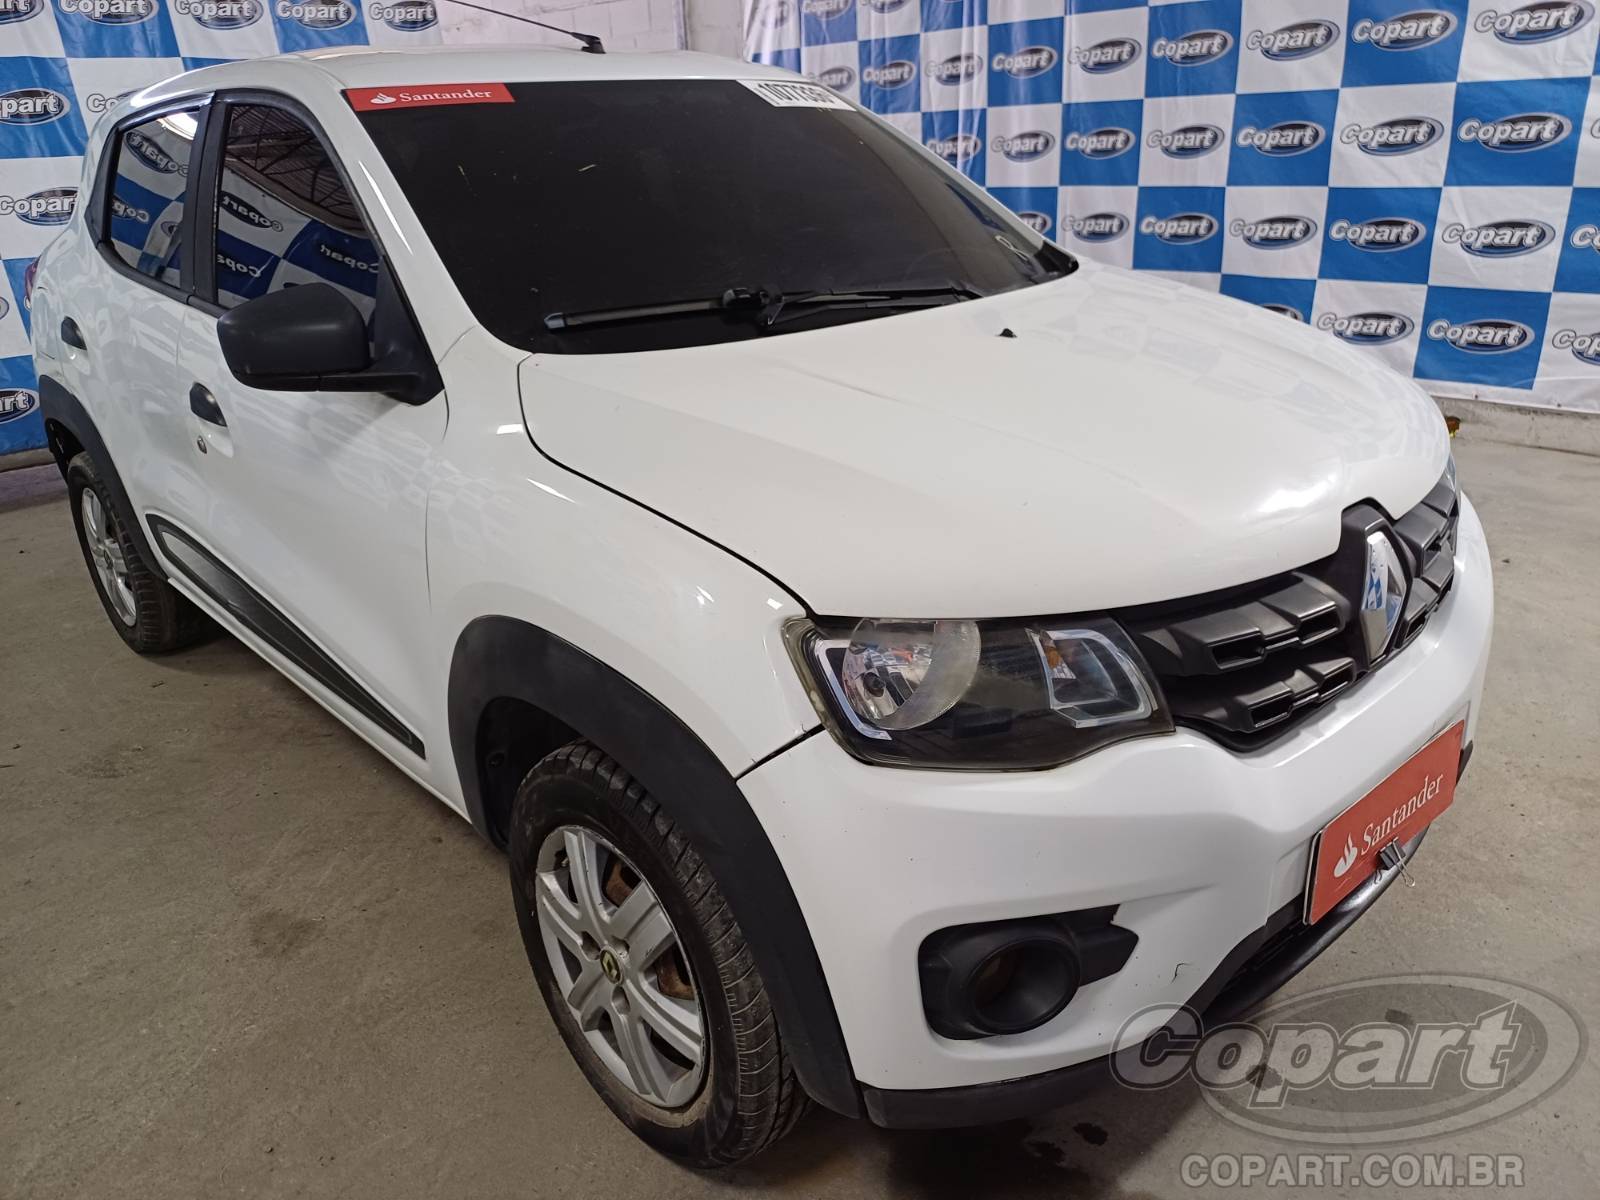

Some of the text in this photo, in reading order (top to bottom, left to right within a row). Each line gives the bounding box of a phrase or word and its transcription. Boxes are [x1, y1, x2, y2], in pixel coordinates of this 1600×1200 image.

[60, 0, 148, 19] Copart
[176, 0, 251, 20] Copart
[276, 1, 347, 22] Copart
[369, 2, 435, 21] Copart
[1474, 4, 1580, 38] Copart
[1246, 23, 1330, 53] Copart
[1352, 12, 1446, 46] Copart
[1067, 40, 1132, 67] Copart
[1152, 32, 1223, 58] Copart
[924, 56, 976, 81] Copart
[992, 49, 1049, 74] Copart
[863, 64, 911, 87] Copart
[0, 93, 59, 115] part
[399, 89, 492, 102] Santander
[991, 133, 1046, 155] Copart
[1065, 129, 1126, 154] Copart
[1146, 128, 1214, 153] Copart
[1236, 123, 1314, 151] Copart
[1340, 123, 1432, 150] Copart
[1458, 117, 1558, 148] Copart
[1062, 215, 1121, 237] Copart
[1139, 216, 1209, 240] Copart
[1229, 216, 1305, 241] Copart
[1329, 218, 1420, 246] Copart
[1441, 222, 1545, 250] Copart
[1316, 312, 1401, 336] Copart
[1427, 318, 1521, 347] Copart
[1552, 329, 1600, 358] Cop
[1361, 773, 1443, 856] Santander
